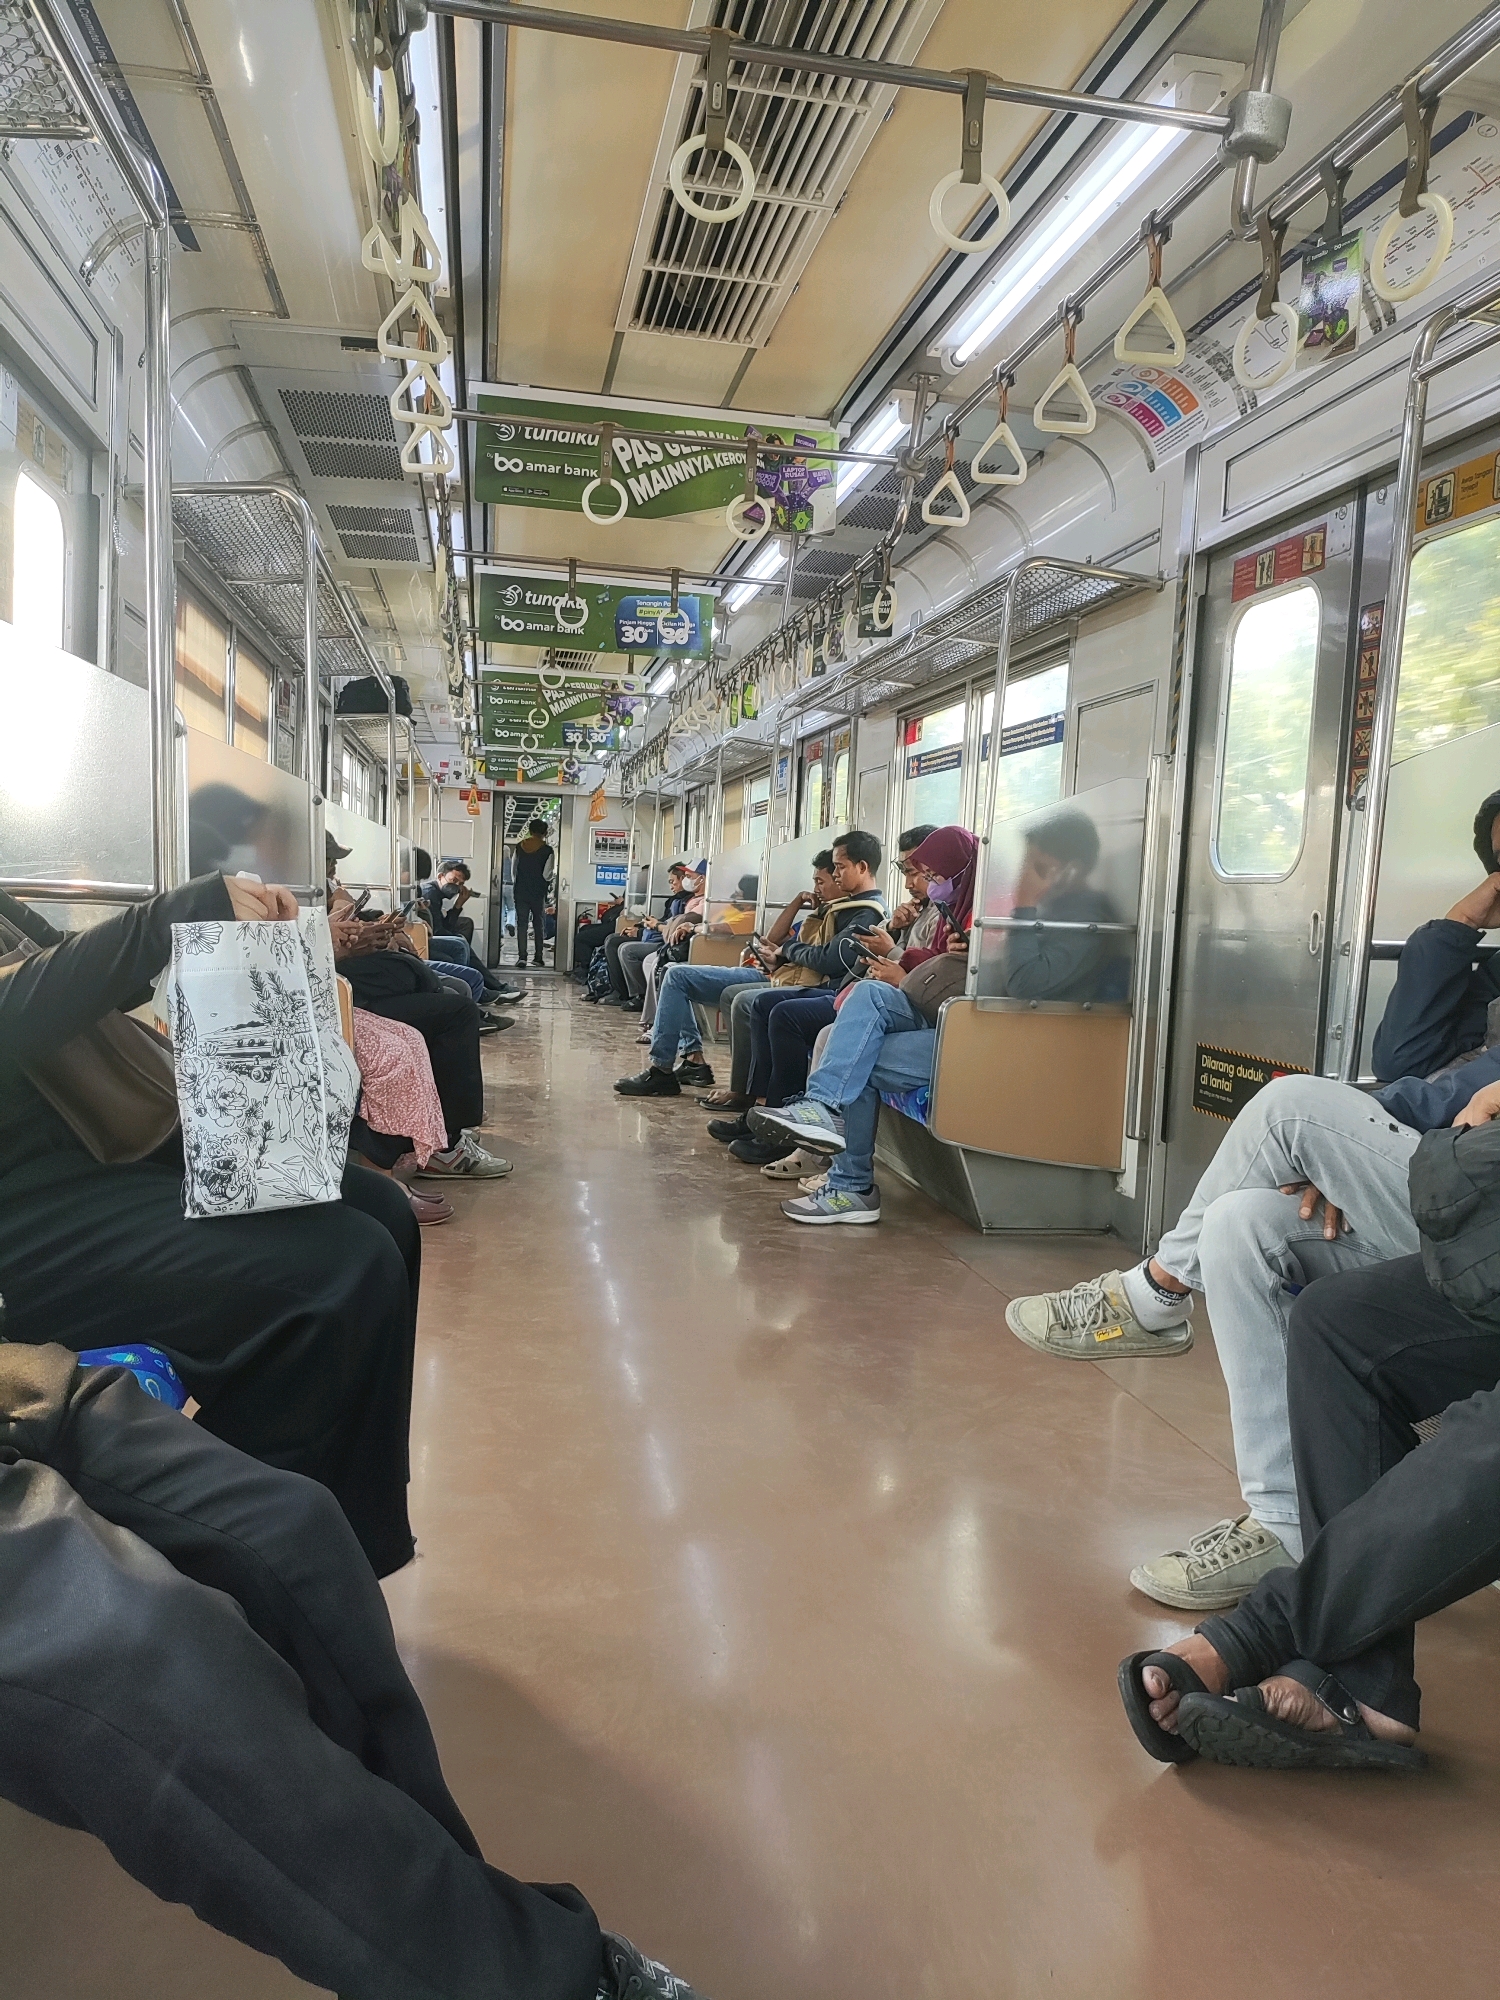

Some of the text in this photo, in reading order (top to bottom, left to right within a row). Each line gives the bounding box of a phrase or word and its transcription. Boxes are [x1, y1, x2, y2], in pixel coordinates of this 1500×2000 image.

[95, 45, 108, 60] Line
[611, 437, 664, 474] PAS
[525, 462, 598, 478] amar bank
[626, 454, 715, 506] MAINNYA
[526, 622, 555, 632] amar
[621, 626, 648, 644] 30
[548, 692, 589, 717] MAINNYA
[1201, 1054, 1264, 1084] Dilarang duduk
[1200, 1072, 1233, 1093] di lantai
